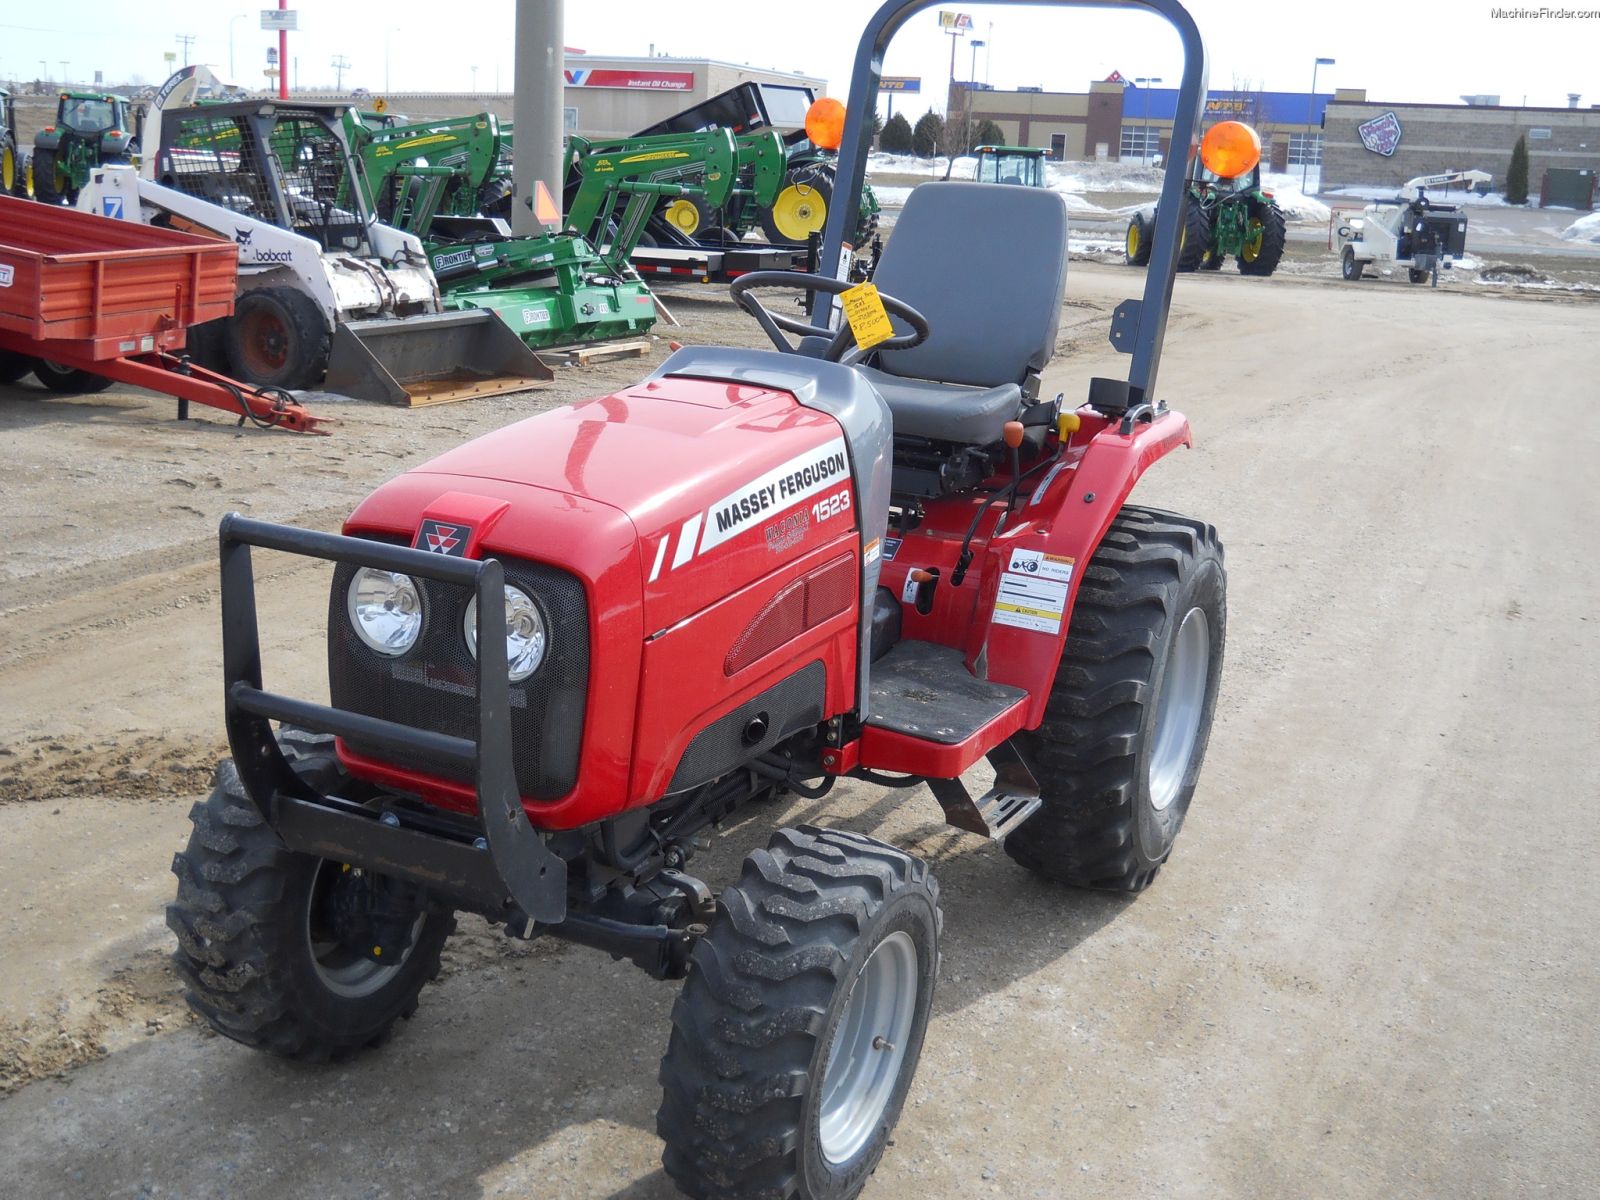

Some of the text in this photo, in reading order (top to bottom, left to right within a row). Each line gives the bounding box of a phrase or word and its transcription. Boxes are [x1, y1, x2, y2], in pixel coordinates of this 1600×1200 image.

[160, 71, 184, 97] TEREX
[627, 79, 651, 87] Instant
[661, 80, 687, 89] Change
[105, 198, 122, 218] 7
[255, 248, 293, 262] bobcat
[434, 250, 473, 269] FRONTIER
[715, 451, 846, 533] MASSEY FERGUSON
[812, 489, 851, 523] 1523
[1021, 607, 1038, 615] CAUTION
